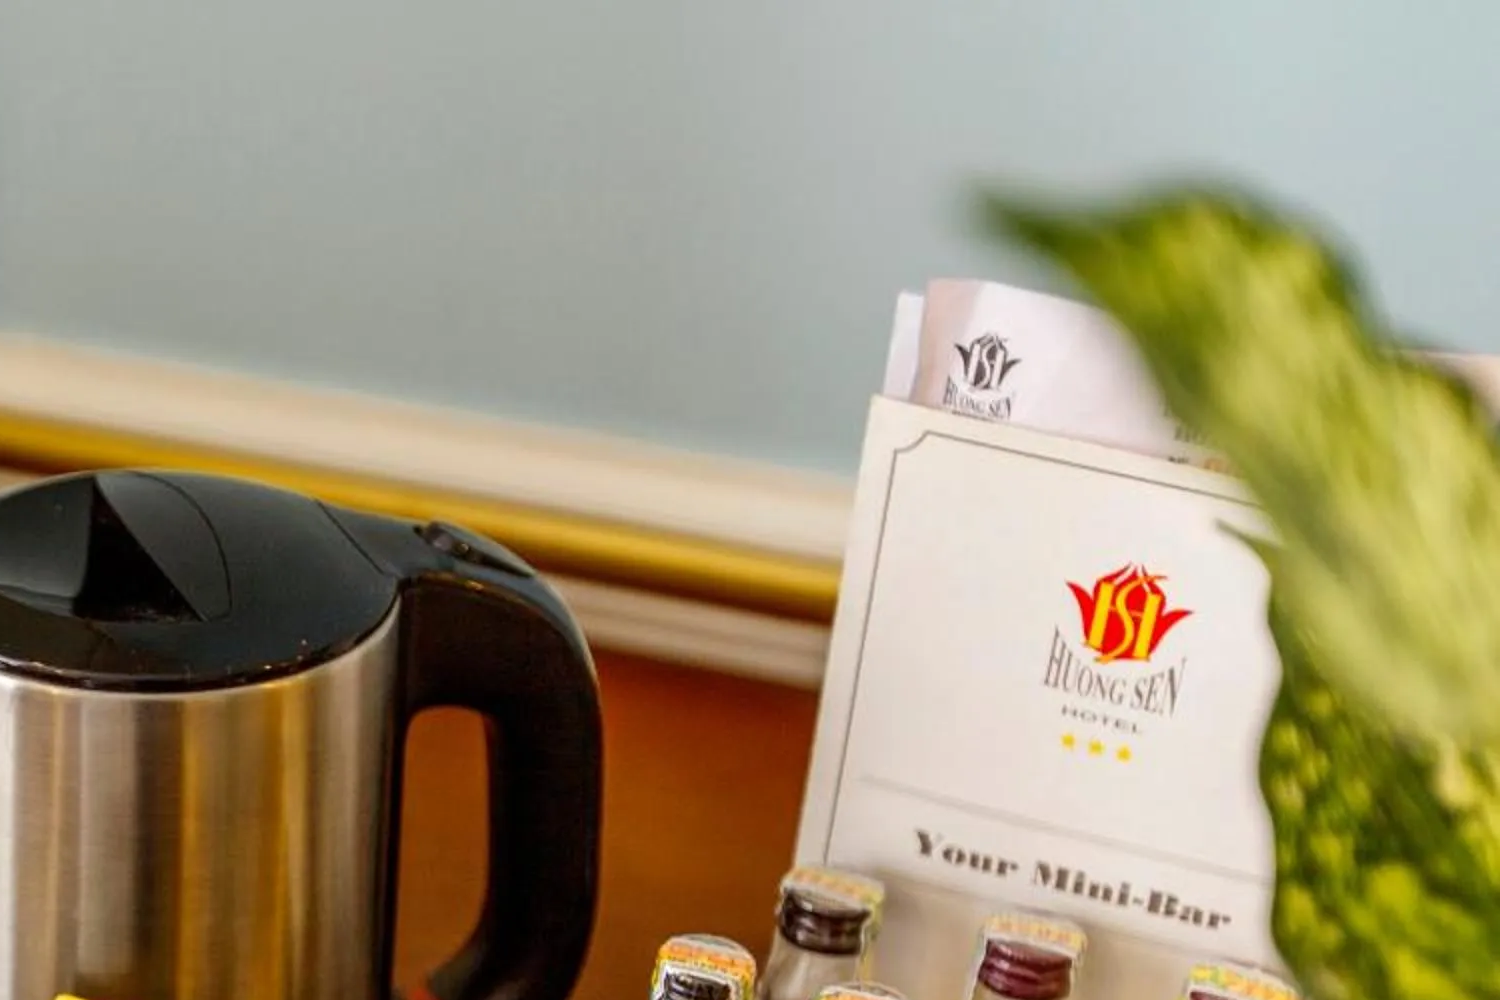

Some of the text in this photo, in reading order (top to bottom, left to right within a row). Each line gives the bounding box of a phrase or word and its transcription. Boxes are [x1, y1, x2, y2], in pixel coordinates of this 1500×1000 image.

[1043, 624, 1188, 721] HUONG SEN
[1060, 703, 1142, 735] HOTEL
[914, 829, 1020, 877] Your
[1033, 858, 1233, 930] Mini-Bar
